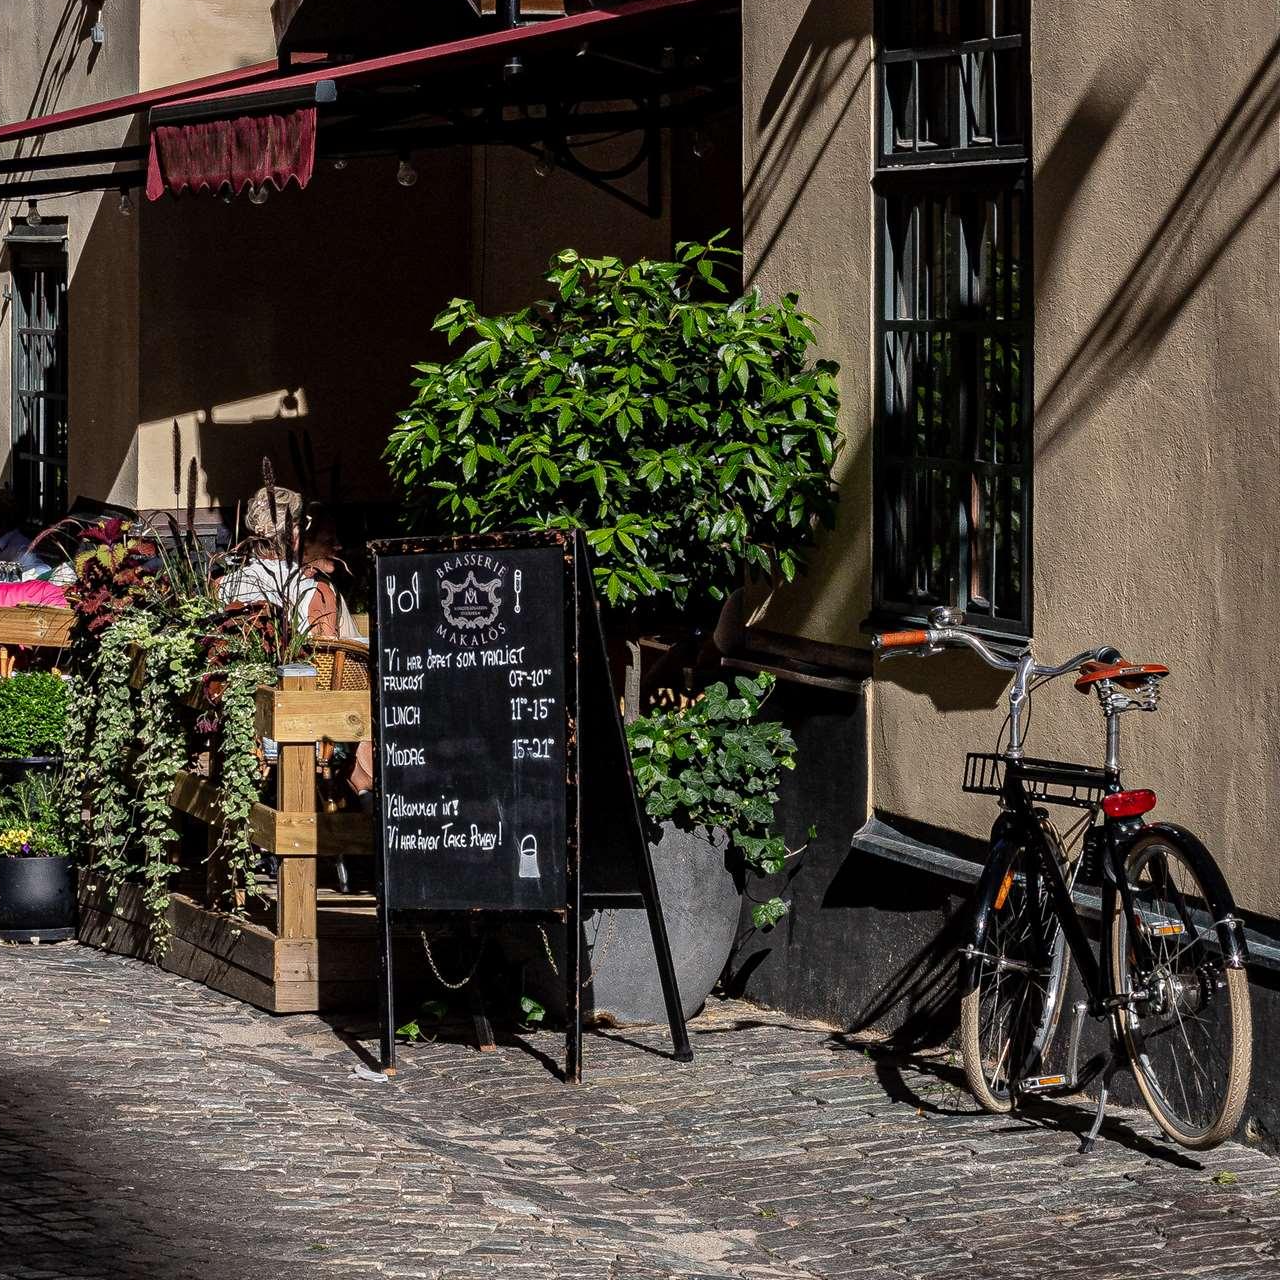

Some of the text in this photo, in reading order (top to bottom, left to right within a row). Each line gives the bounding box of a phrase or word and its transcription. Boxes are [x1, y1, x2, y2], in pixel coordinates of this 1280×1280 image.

[436, 554, 507, 578] BRASSERIE
[436, 623, 506, 647] MAKALÖS
[406, 655, 423, 671] HAR
[456, 651, 477, 668] SOM
[383, 673, 425, 692] FRUKOST
[384, 706, 420, 728] LUNCH
[400, 834, 417, 851] HAR
